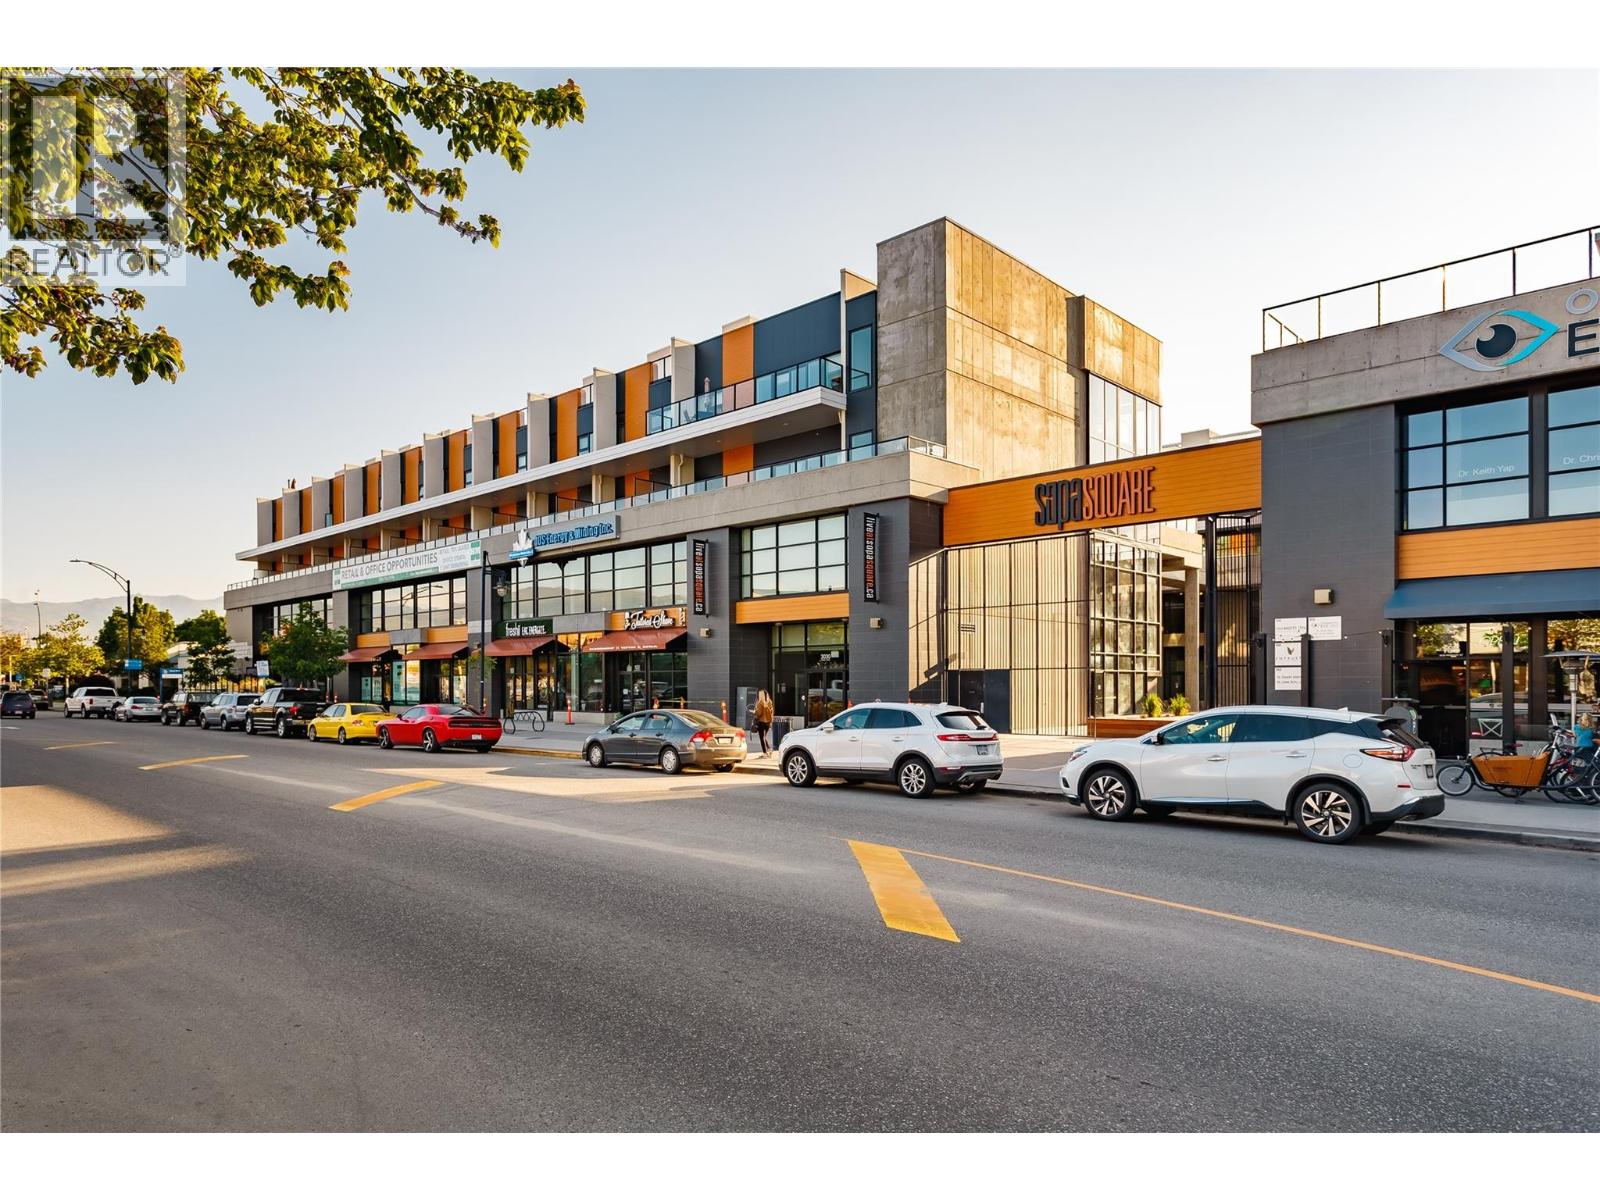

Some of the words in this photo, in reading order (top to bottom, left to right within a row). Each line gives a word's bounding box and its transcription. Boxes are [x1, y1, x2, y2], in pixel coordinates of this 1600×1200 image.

[341, 568, 359, 580] RETAIL
[360, 567, 364, 577] &
[365, 562, 386, 576] OFFICE
[387, 552, 438, 572] OPPORTUNITIES
